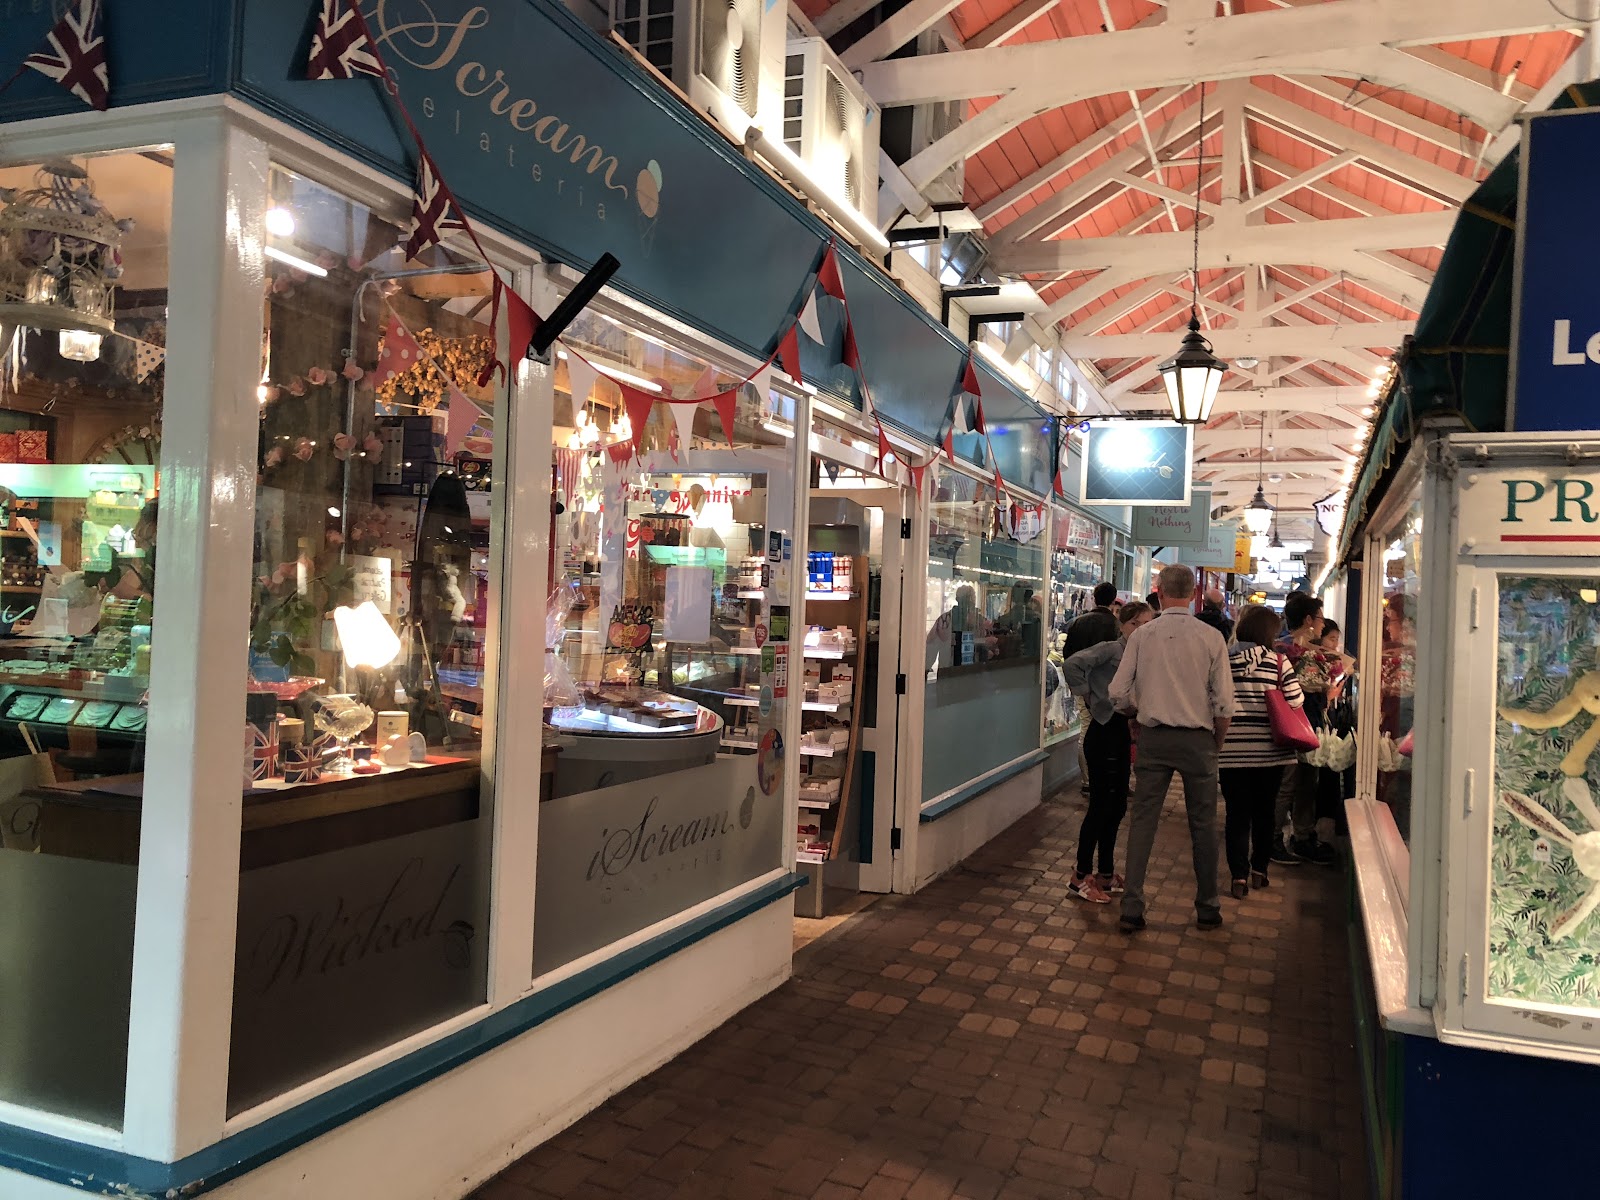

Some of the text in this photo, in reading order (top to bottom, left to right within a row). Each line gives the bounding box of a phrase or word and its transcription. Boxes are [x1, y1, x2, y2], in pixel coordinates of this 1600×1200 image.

[1148, 514, 1193, 534] Nothing
[1501, 478, 1600, 523] PR
[585, 795, 735, 882] iScream
[250, 856, 461, 996] Wicked
